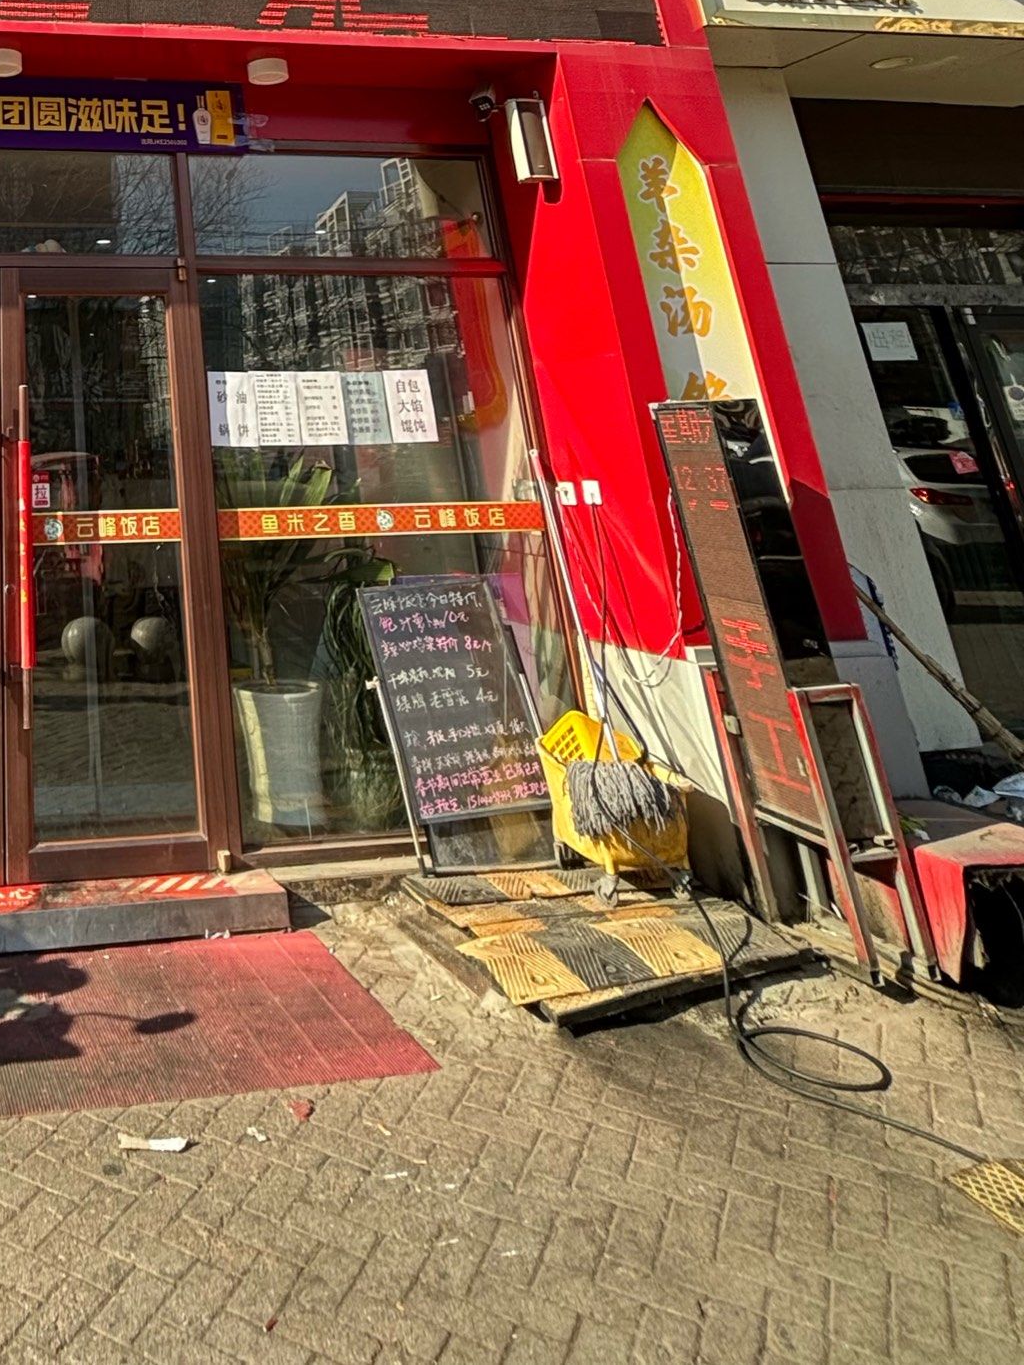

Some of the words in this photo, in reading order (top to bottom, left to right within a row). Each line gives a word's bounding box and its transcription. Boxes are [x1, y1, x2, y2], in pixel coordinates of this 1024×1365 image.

[638, 155, 714, 339] 羊杂汤
[33, 485, 47, 500] 拉
[77, 515, 161, 538] 云峰饭店
[260, 510, 357, 533] 鱼米之香
[414, 507, 506, 529] 云峰饭店
